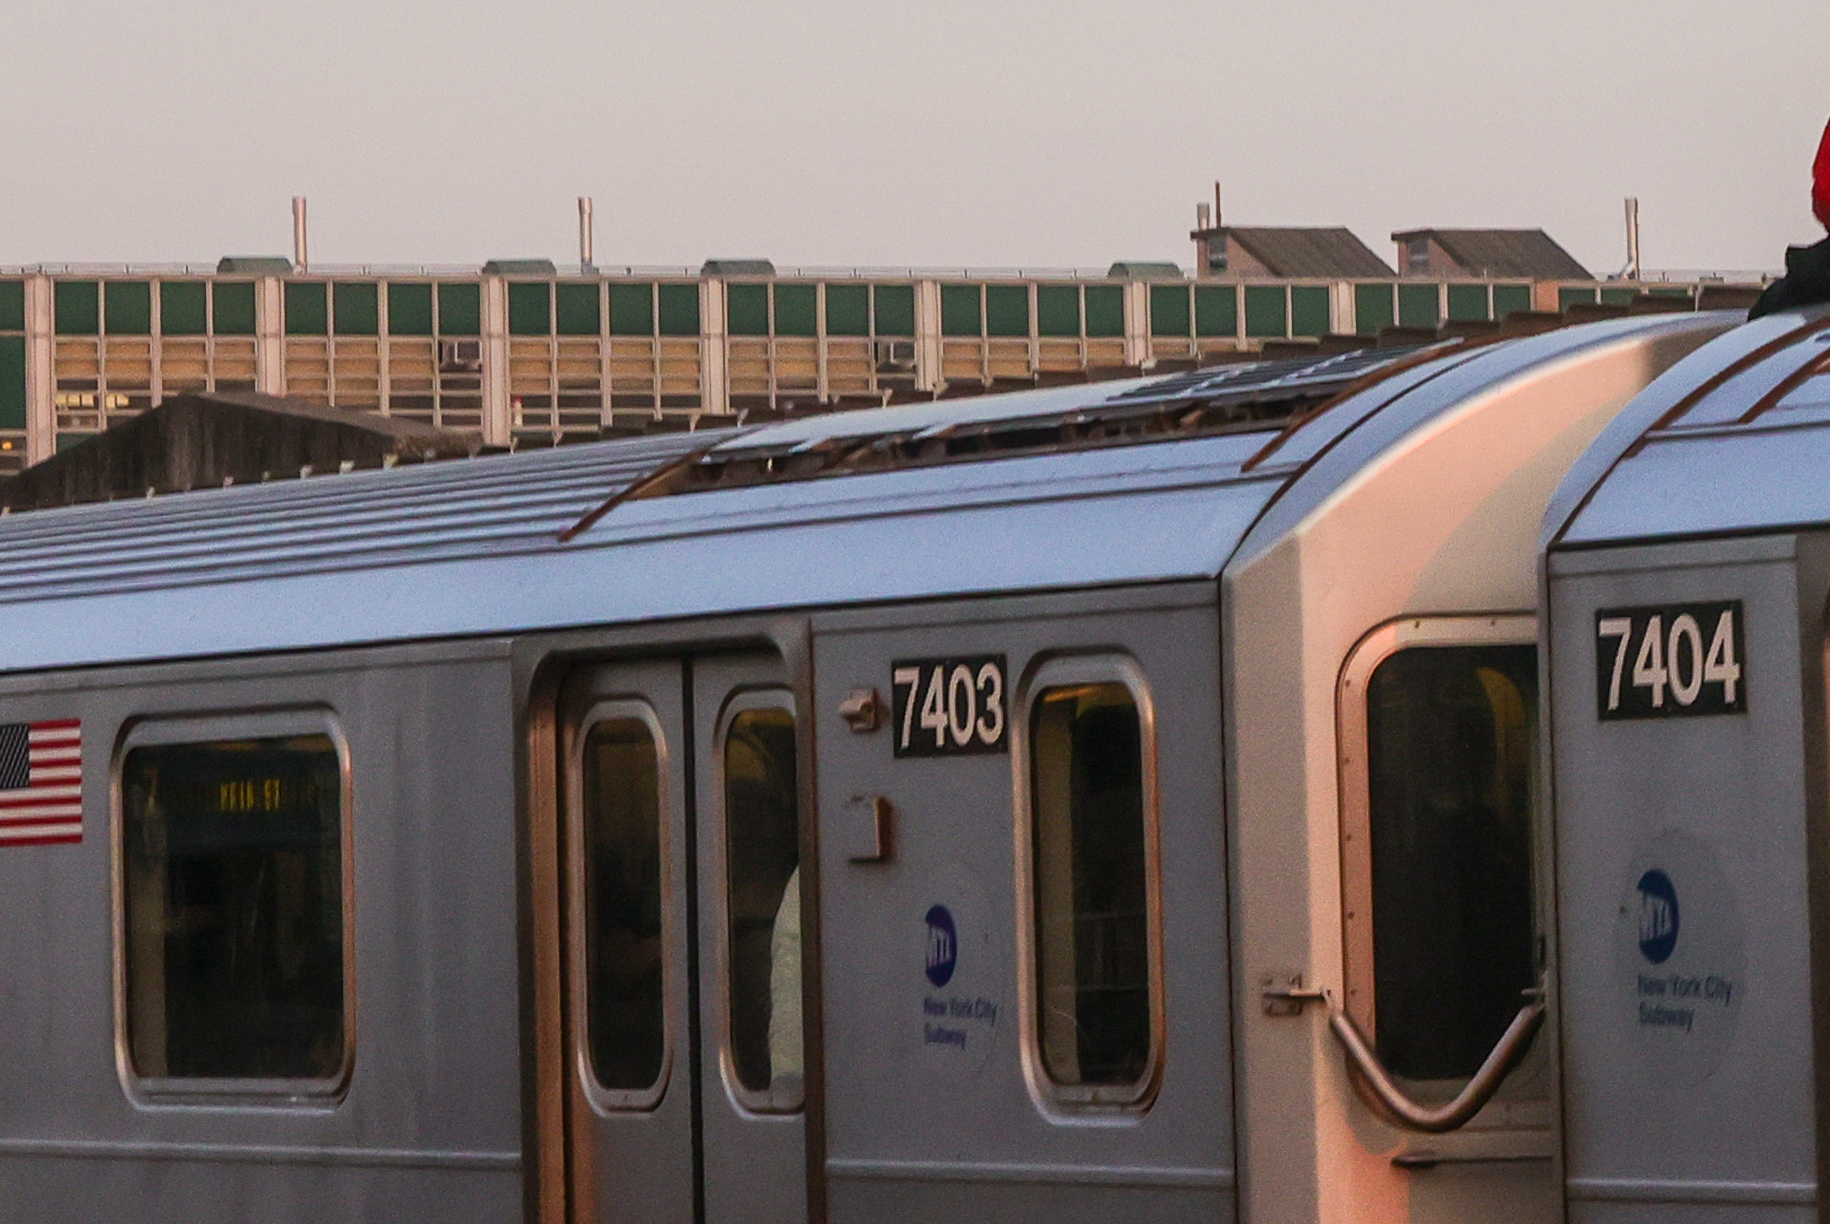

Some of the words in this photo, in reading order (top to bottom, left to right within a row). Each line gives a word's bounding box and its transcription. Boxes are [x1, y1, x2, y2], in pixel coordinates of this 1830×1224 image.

[1599, 610, 1740, 711] 7404
[894, 662, 1004, 750] 7403
[1668, 975, 1700, 997] York
[1704, 976, 1732, 1007] City
[975, 997, 997, 1026] City
[1639, 1001, 1695, 1033] Subway
[925, 1022, 966, 1050] Subway
